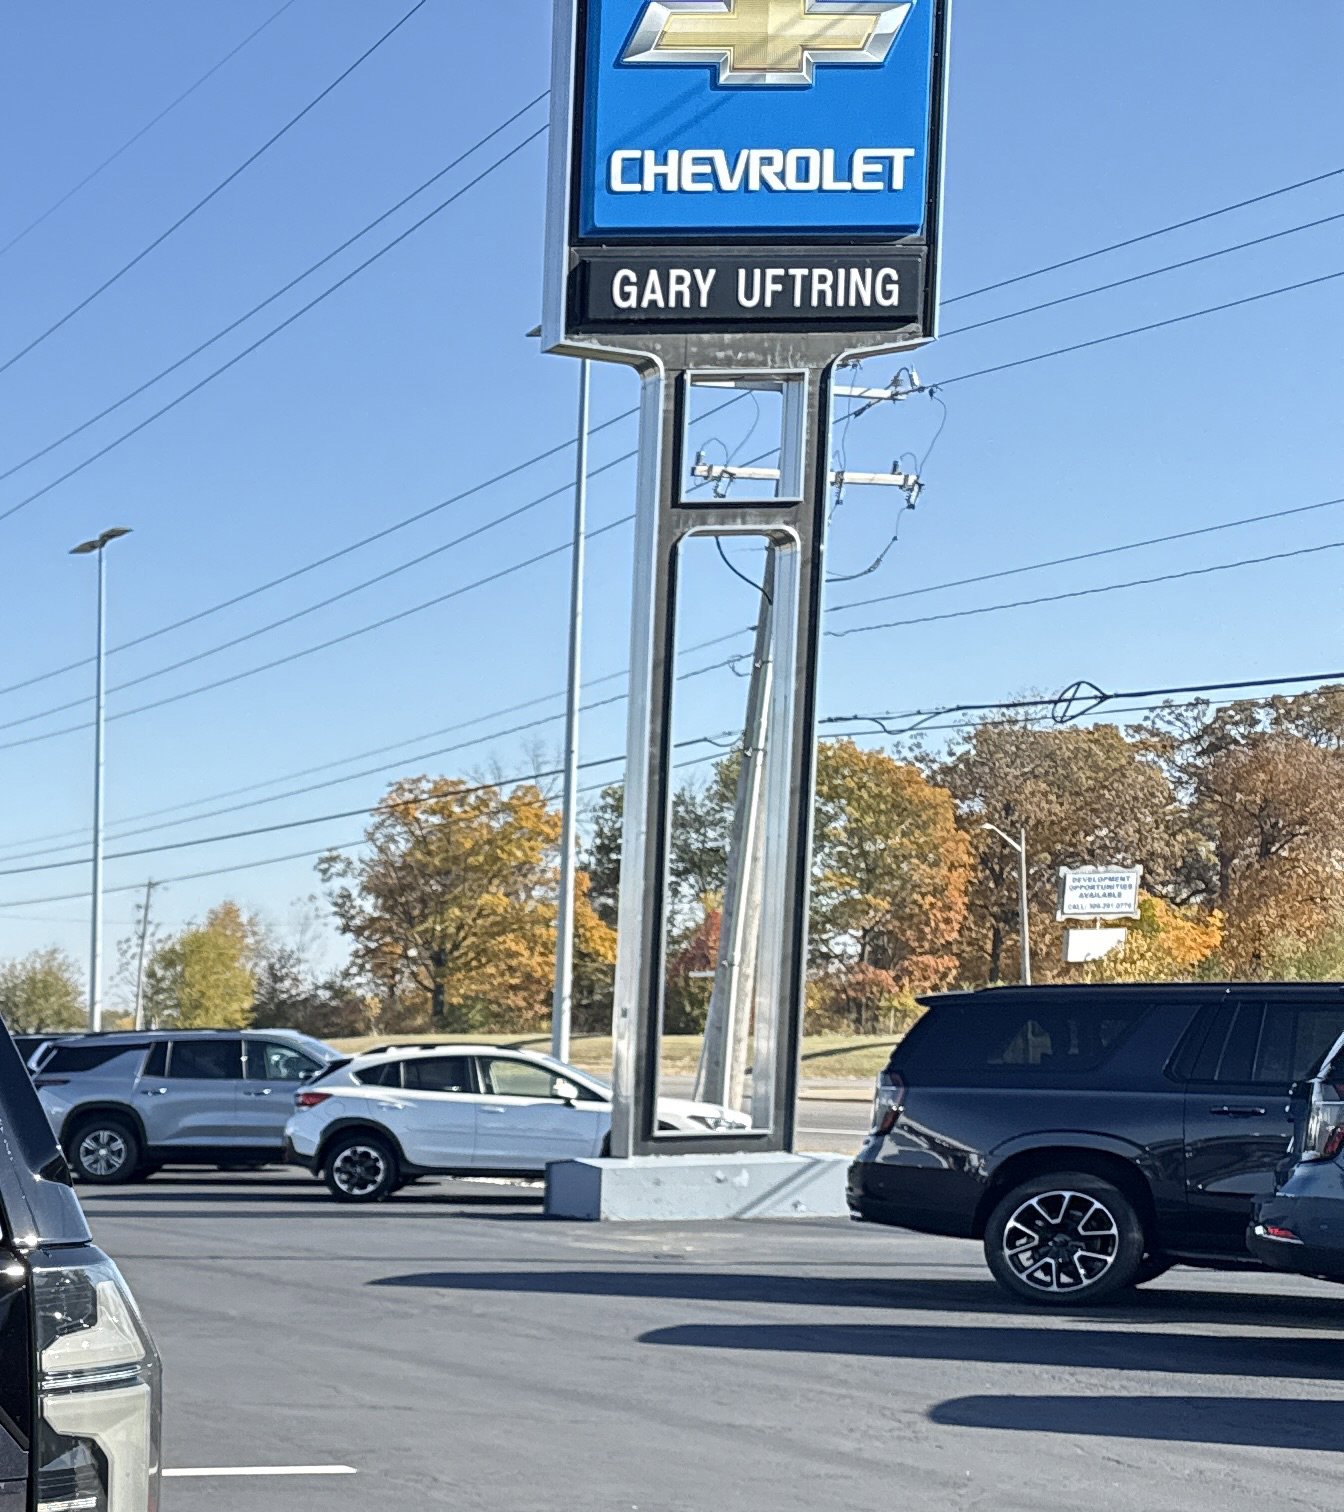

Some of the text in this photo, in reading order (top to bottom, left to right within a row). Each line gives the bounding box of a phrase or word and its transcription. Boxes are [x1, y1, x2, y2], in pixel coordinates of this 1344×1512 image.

[611, 148, 915, 193] CHEVROLET
[612, 267, 900, 308] GARY UFTRING
